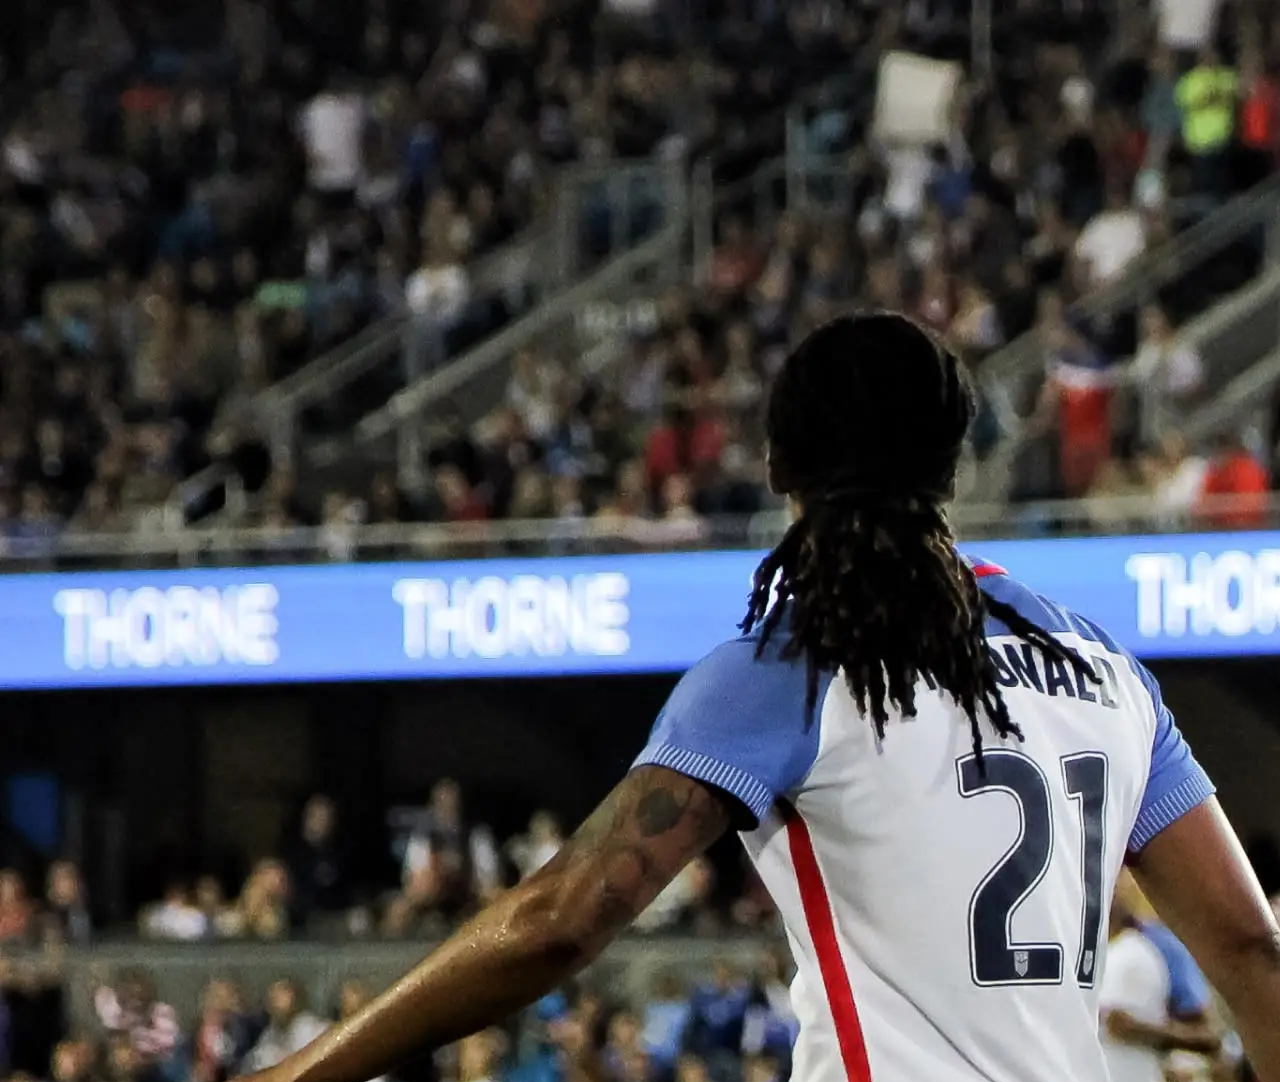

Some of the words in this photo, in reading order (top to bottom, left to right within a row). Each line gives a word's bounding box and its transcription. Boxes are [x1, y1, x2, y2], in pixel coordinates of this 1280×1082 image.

[53, 583, 280, 670] THORNE
[392, 572, 630, 658] THORNE
[955, 748, 1109, 989] 21
